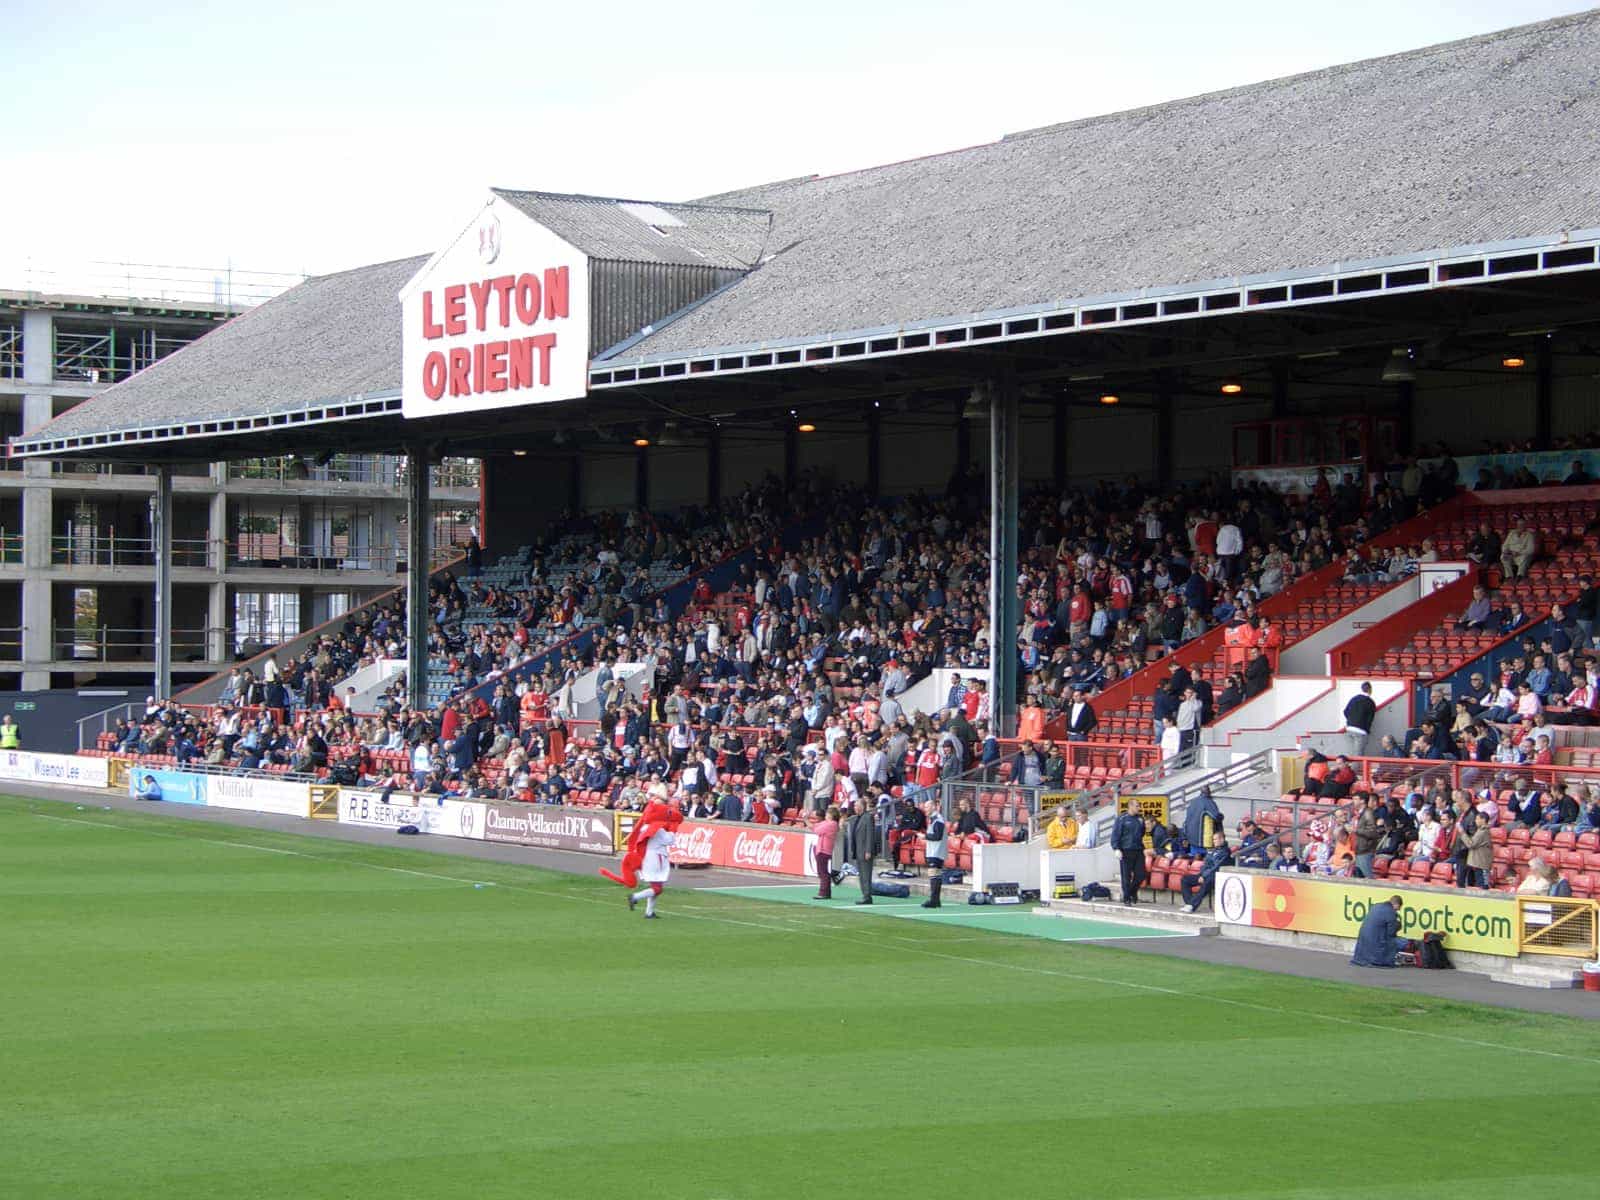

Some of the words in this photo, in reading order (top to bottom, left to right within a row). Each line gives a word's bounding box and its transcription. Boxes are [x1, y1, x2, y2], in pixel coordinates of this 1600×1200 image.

[422, 265, 570, 340] LEYTON
[422, 332, 557, 401] ORIENT
[349, 797, 371, 820] R.B.
